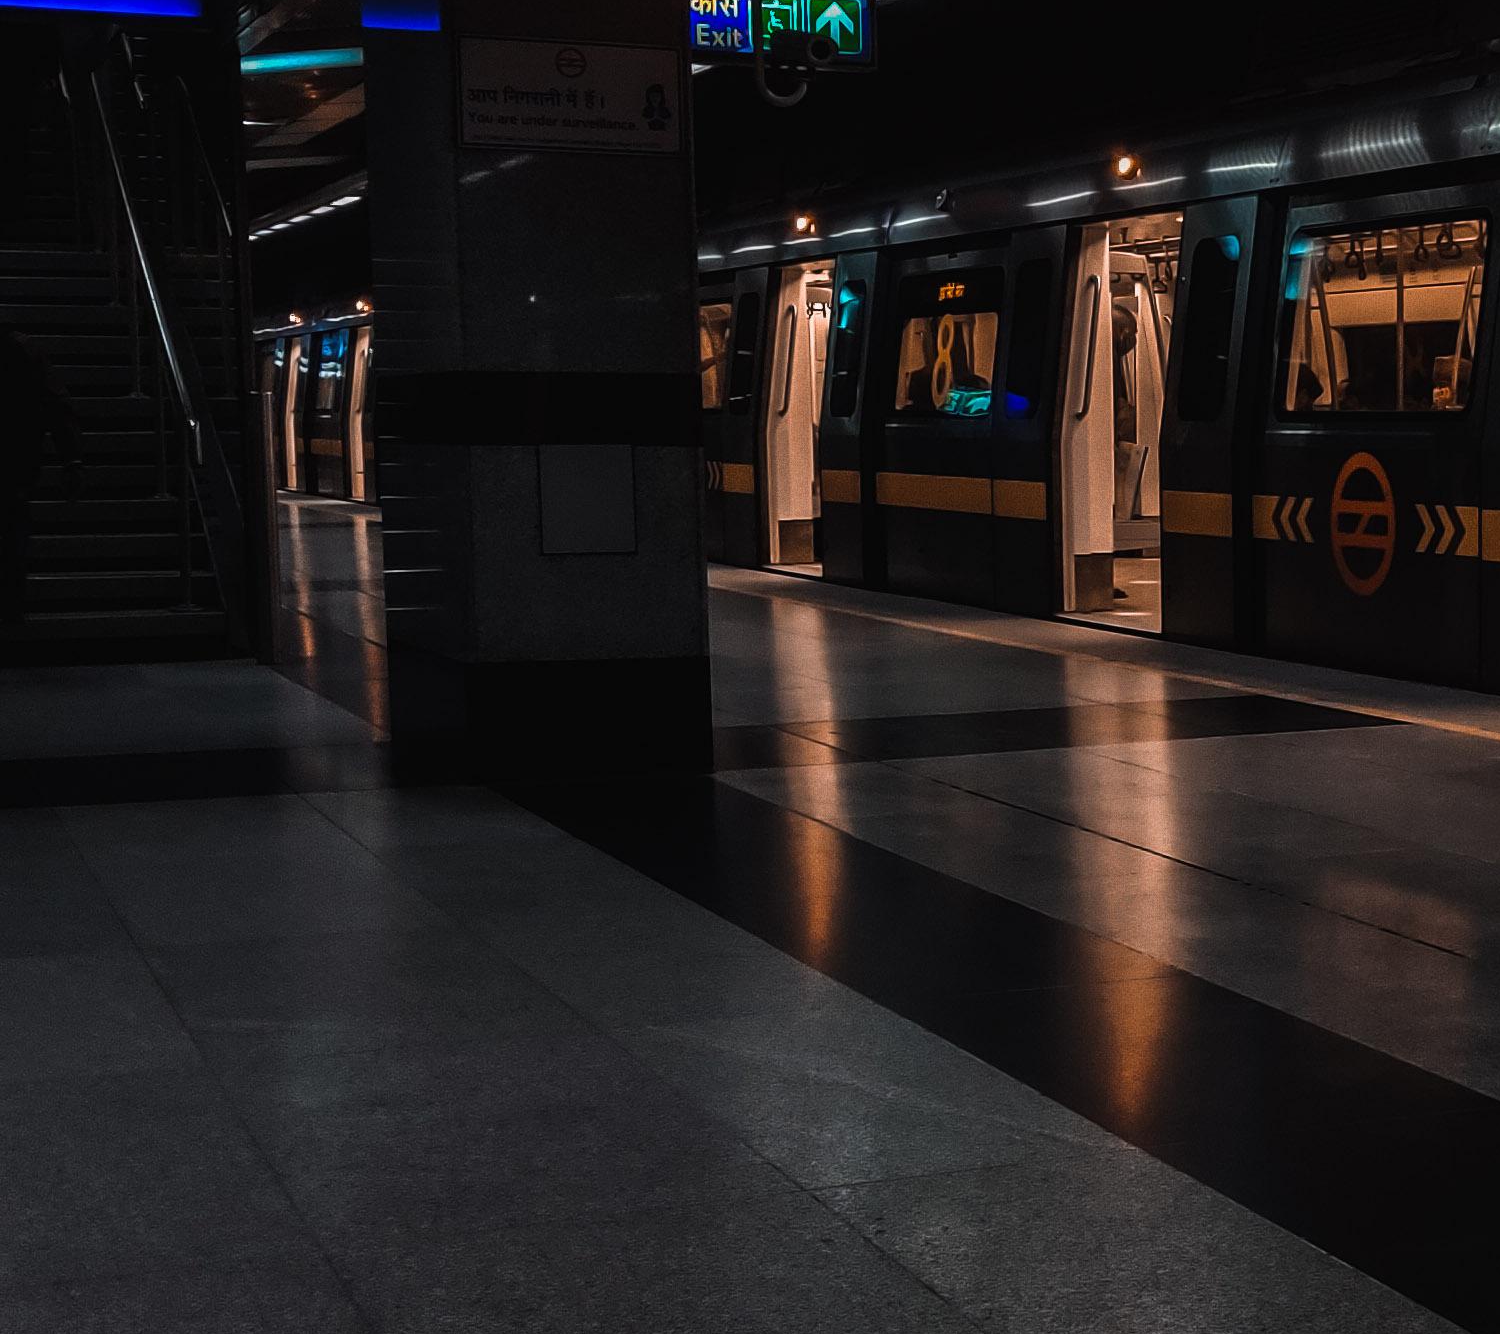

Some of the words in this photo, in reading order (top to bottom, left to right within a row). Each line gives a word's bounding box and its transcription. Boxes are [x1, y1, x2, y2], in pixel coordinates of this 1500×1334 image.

[696, 23, 744, 49] Exit
[467, 89, 497, 104] आप
[503, 85, 561, 107] निगरानी
[467, 111, 494, 124] You
[497, 115, 517, 125] are
[522, 115, 558, 127] under
[562, 117, 640, 131] surveillance.
